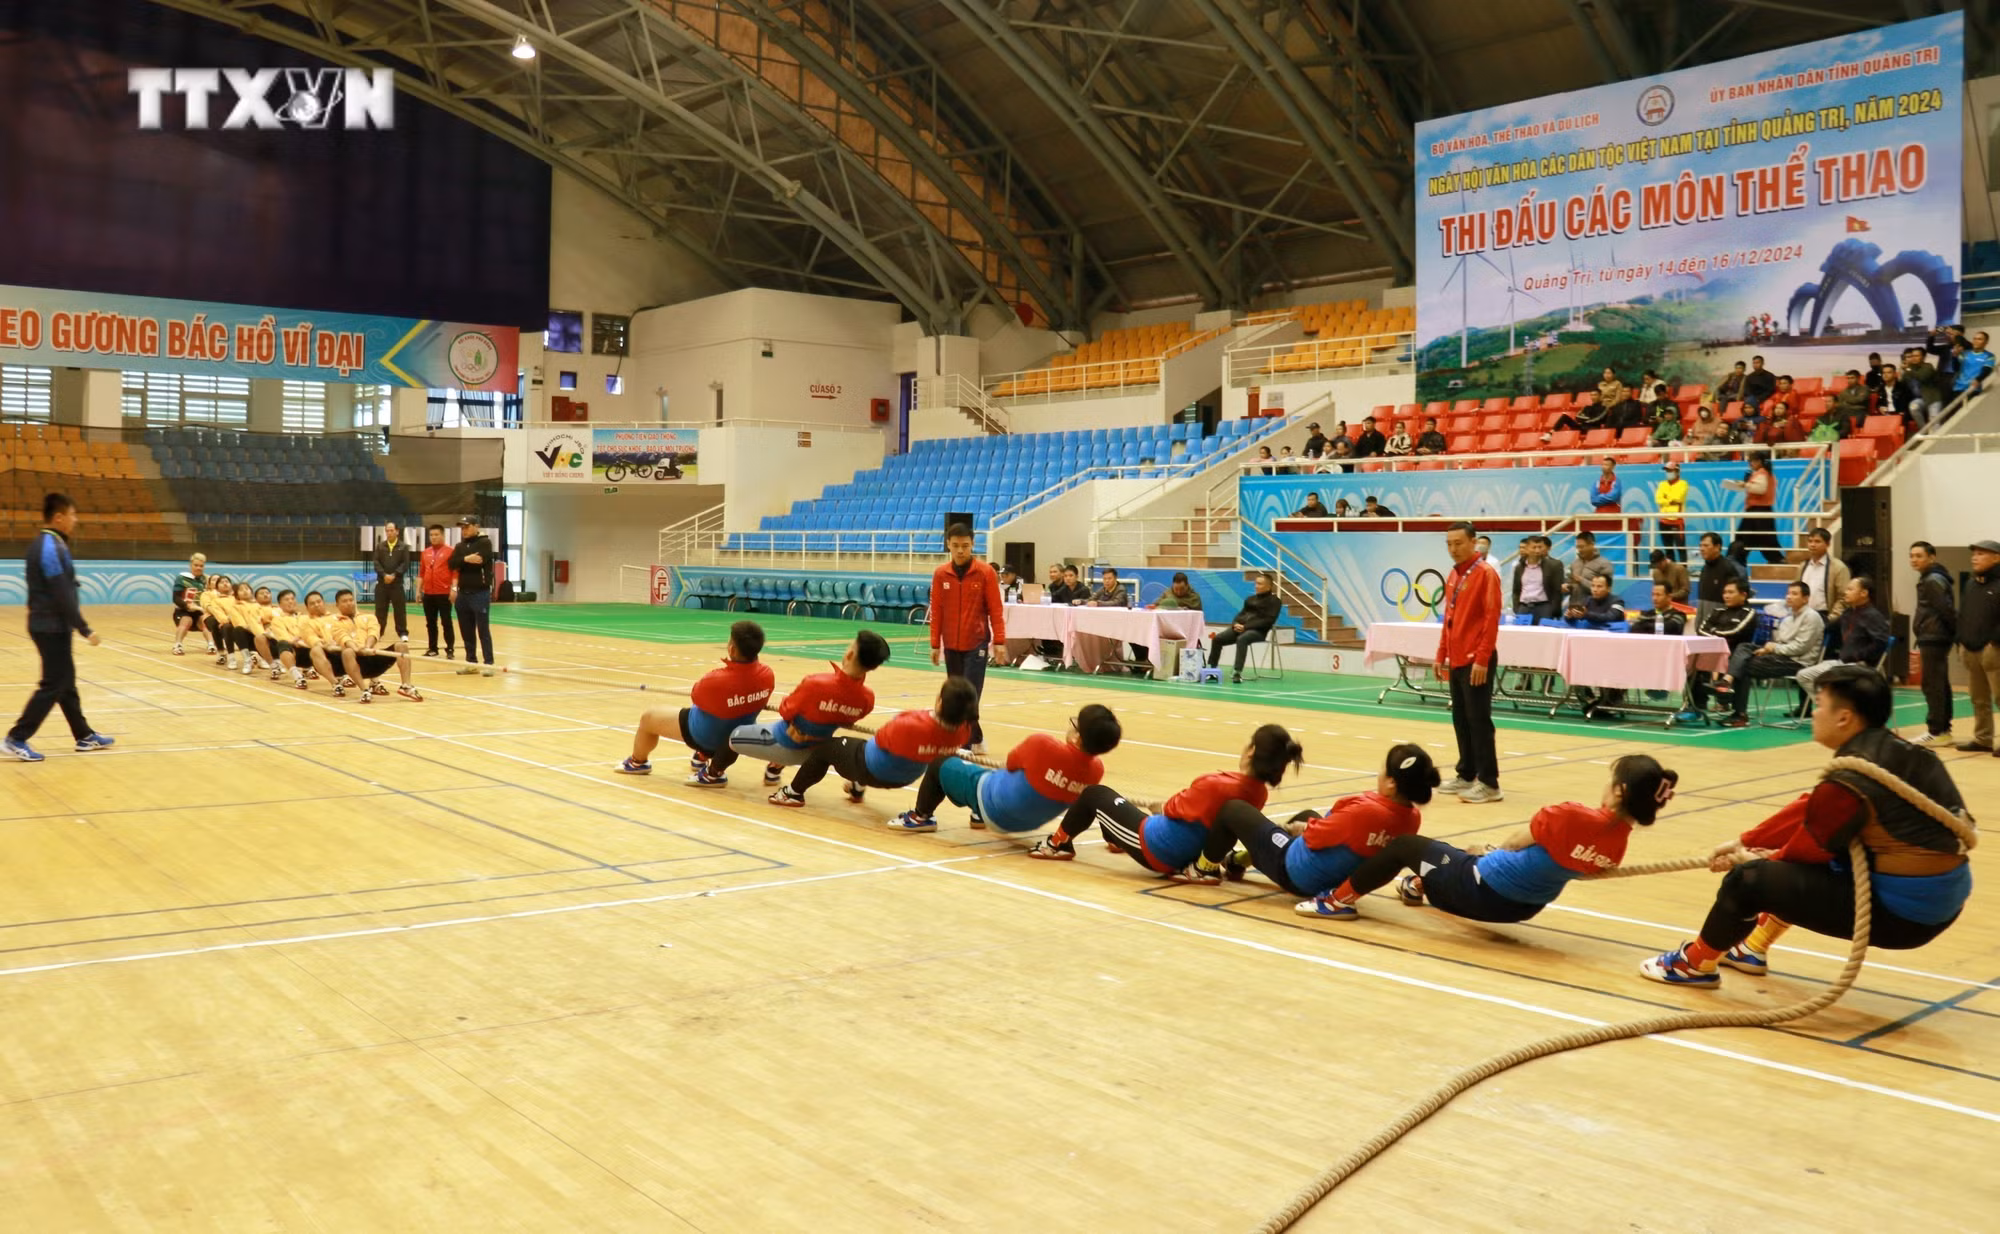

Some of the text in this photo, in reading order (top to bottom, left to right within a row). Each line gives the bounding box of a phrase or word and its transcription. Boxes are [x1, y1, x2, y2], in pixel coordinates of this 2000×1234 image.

[1729, 84, 1754, 100] BAN
[1758, 74, 1793, 94] NHÂN
[1797, 68, 1824, 87] DÂN
[1863, 53, 1911, 76] QUẢNG
[1915, 47, 1939, 64] TRỊ
[1429, 88, 1942, 196] NGÀY HỘI VĂN HÓA CÁC DÂN TỘC VIỆT NAM TẠI TỈNH QUẢNG TRỊ, NĂM 2024
[1514, 125, 1540, 139] THAO
[1558, 119, 1572, 131] DU
[1574, 113, 1599, 129] LỊCH
[1441, 142, 1927, 256] THI ĐẤU CÁC MÔN THỂ THAO
[1523, 273, 1567, 291] Quảng
[1615, 264, 1652, 282] ngày
[1658, 260, 1674, 275] 14
[1677, 253, 1706, 273] đến
[51, 311, 159, 357] GƯƠNG
[167, 314, 228, 361] BÁC
[236, 315, 276, 364] HỒ
[282, 324, 312, 366] VĨ
[316, 331, 365, 377] ĐẠI
[837, 385, 842, 394] 2
[1333, 655, 1340, 670] 3
